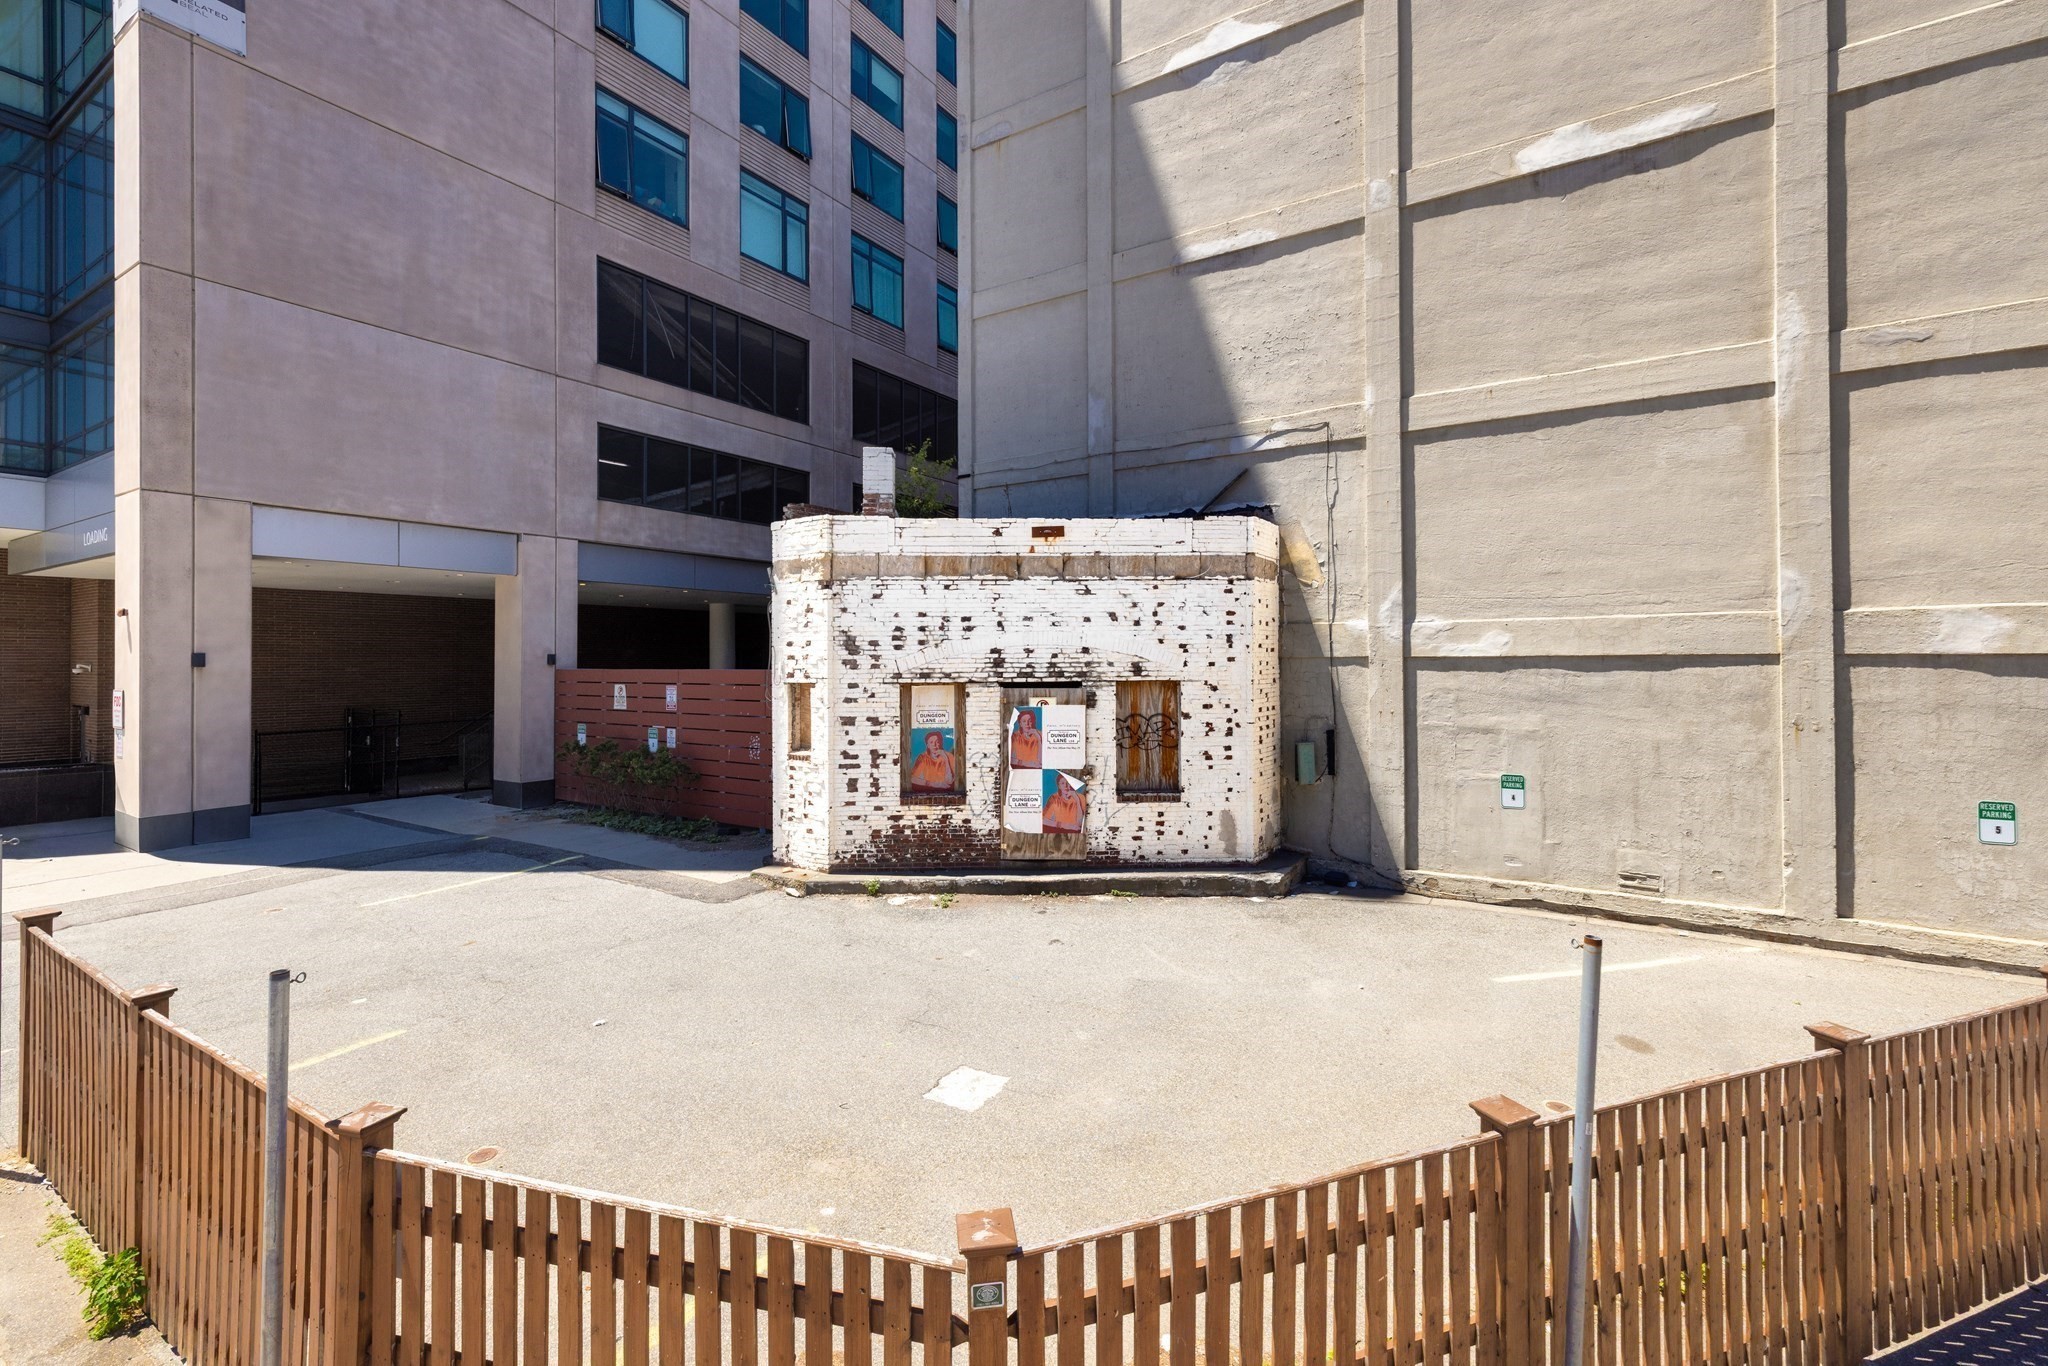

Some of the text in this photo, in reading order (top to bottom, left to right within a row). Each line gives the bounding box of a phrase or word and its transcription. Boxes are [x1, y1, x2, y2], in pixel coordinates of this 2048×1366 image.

[180, 1, 208, 18] BEAL
[180, 0, 228, 21] ELATED
[83, 527, 108, 546] LOADING
[1980, 803, 2014, 811] RESERVED
[1982, 810, 2012, 819] PARKING
[1995, 825, 2001, 834] 5
